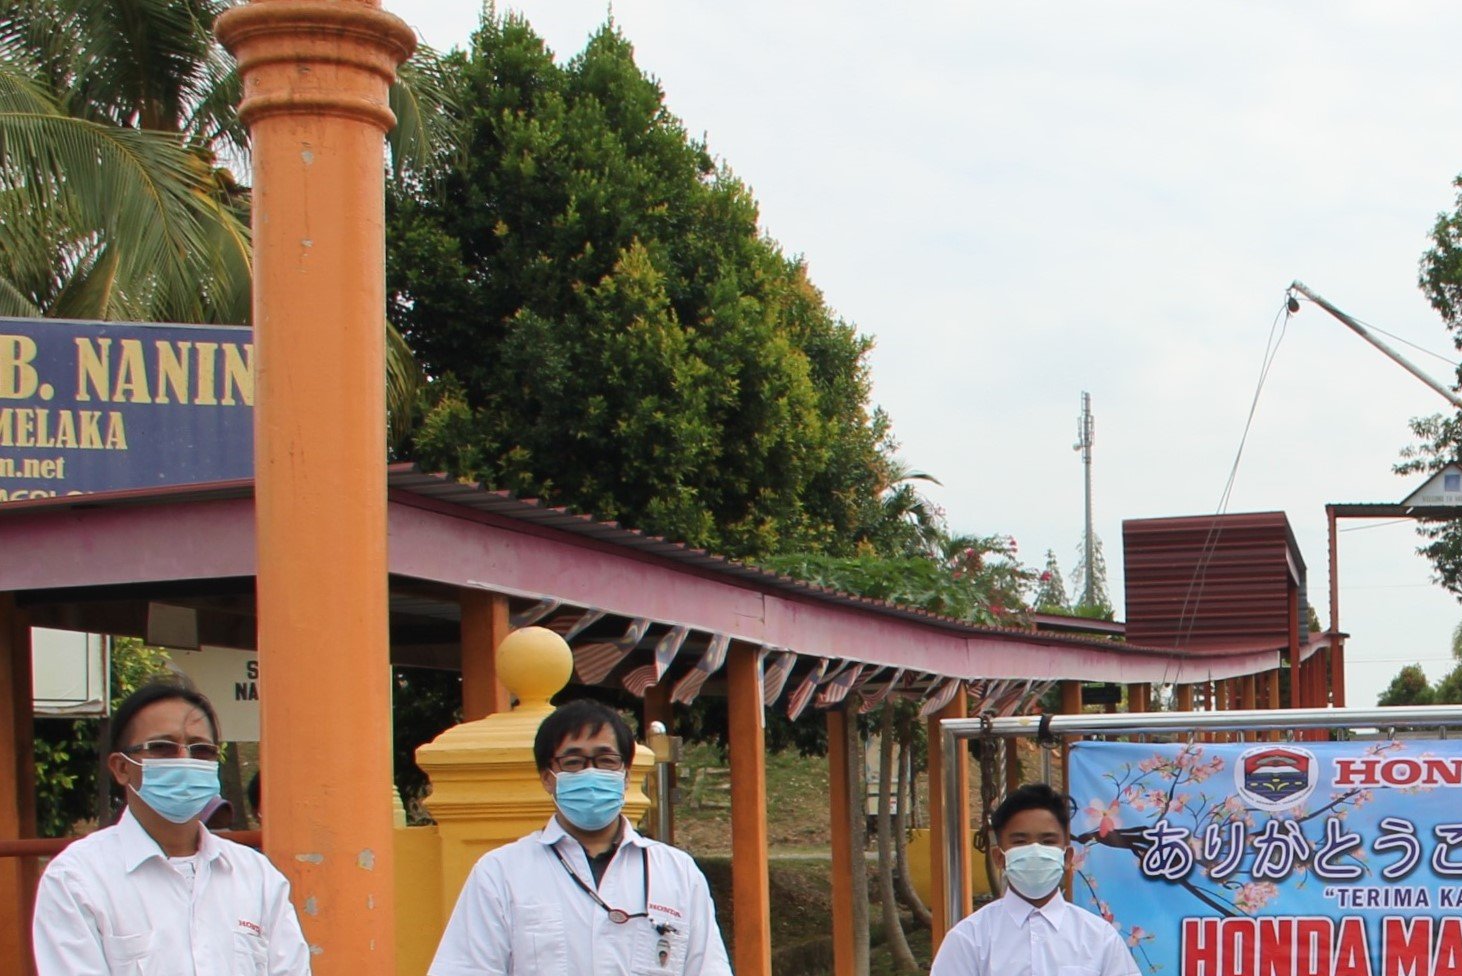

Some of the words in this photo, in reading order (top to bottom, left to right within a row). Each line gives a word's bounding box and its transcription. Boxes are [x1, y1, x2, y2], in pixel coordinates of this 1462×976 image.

[75, 337, 253, 406] NANIN
[1325, 887, 1431, 908] “TERIMA
[649, 904, 682, 918] HONDA
